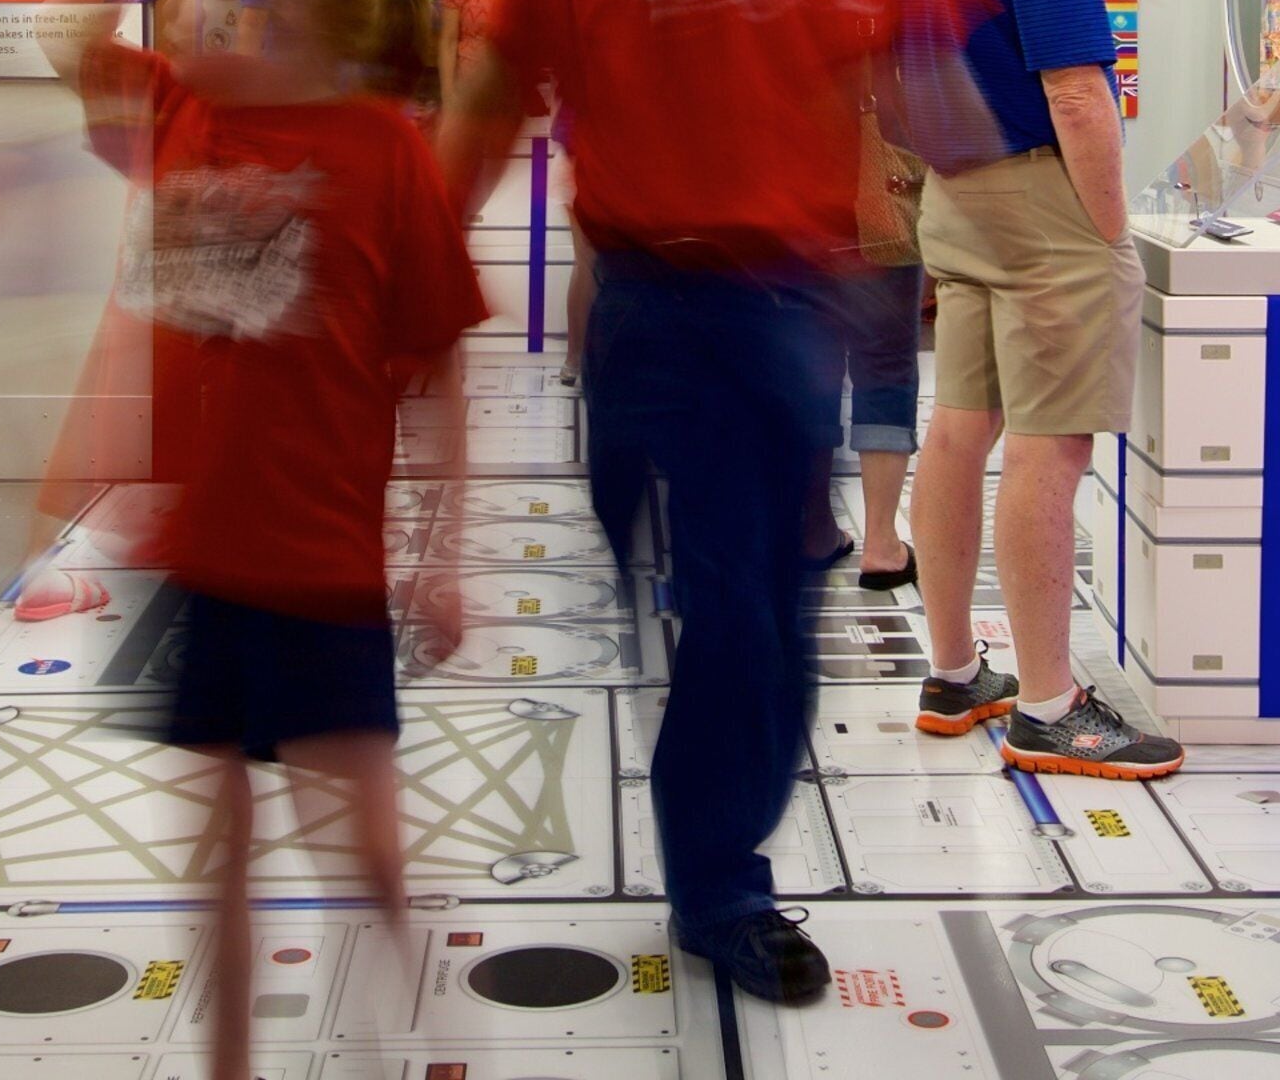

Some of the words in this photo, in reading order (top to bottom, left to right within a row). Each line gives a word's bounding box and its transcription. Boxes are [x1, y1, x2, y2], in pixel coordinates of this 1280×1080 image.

[11, 15, 20, 24] is
[22, 15, 32, 24] in
[25, 29, 33, 39] it
